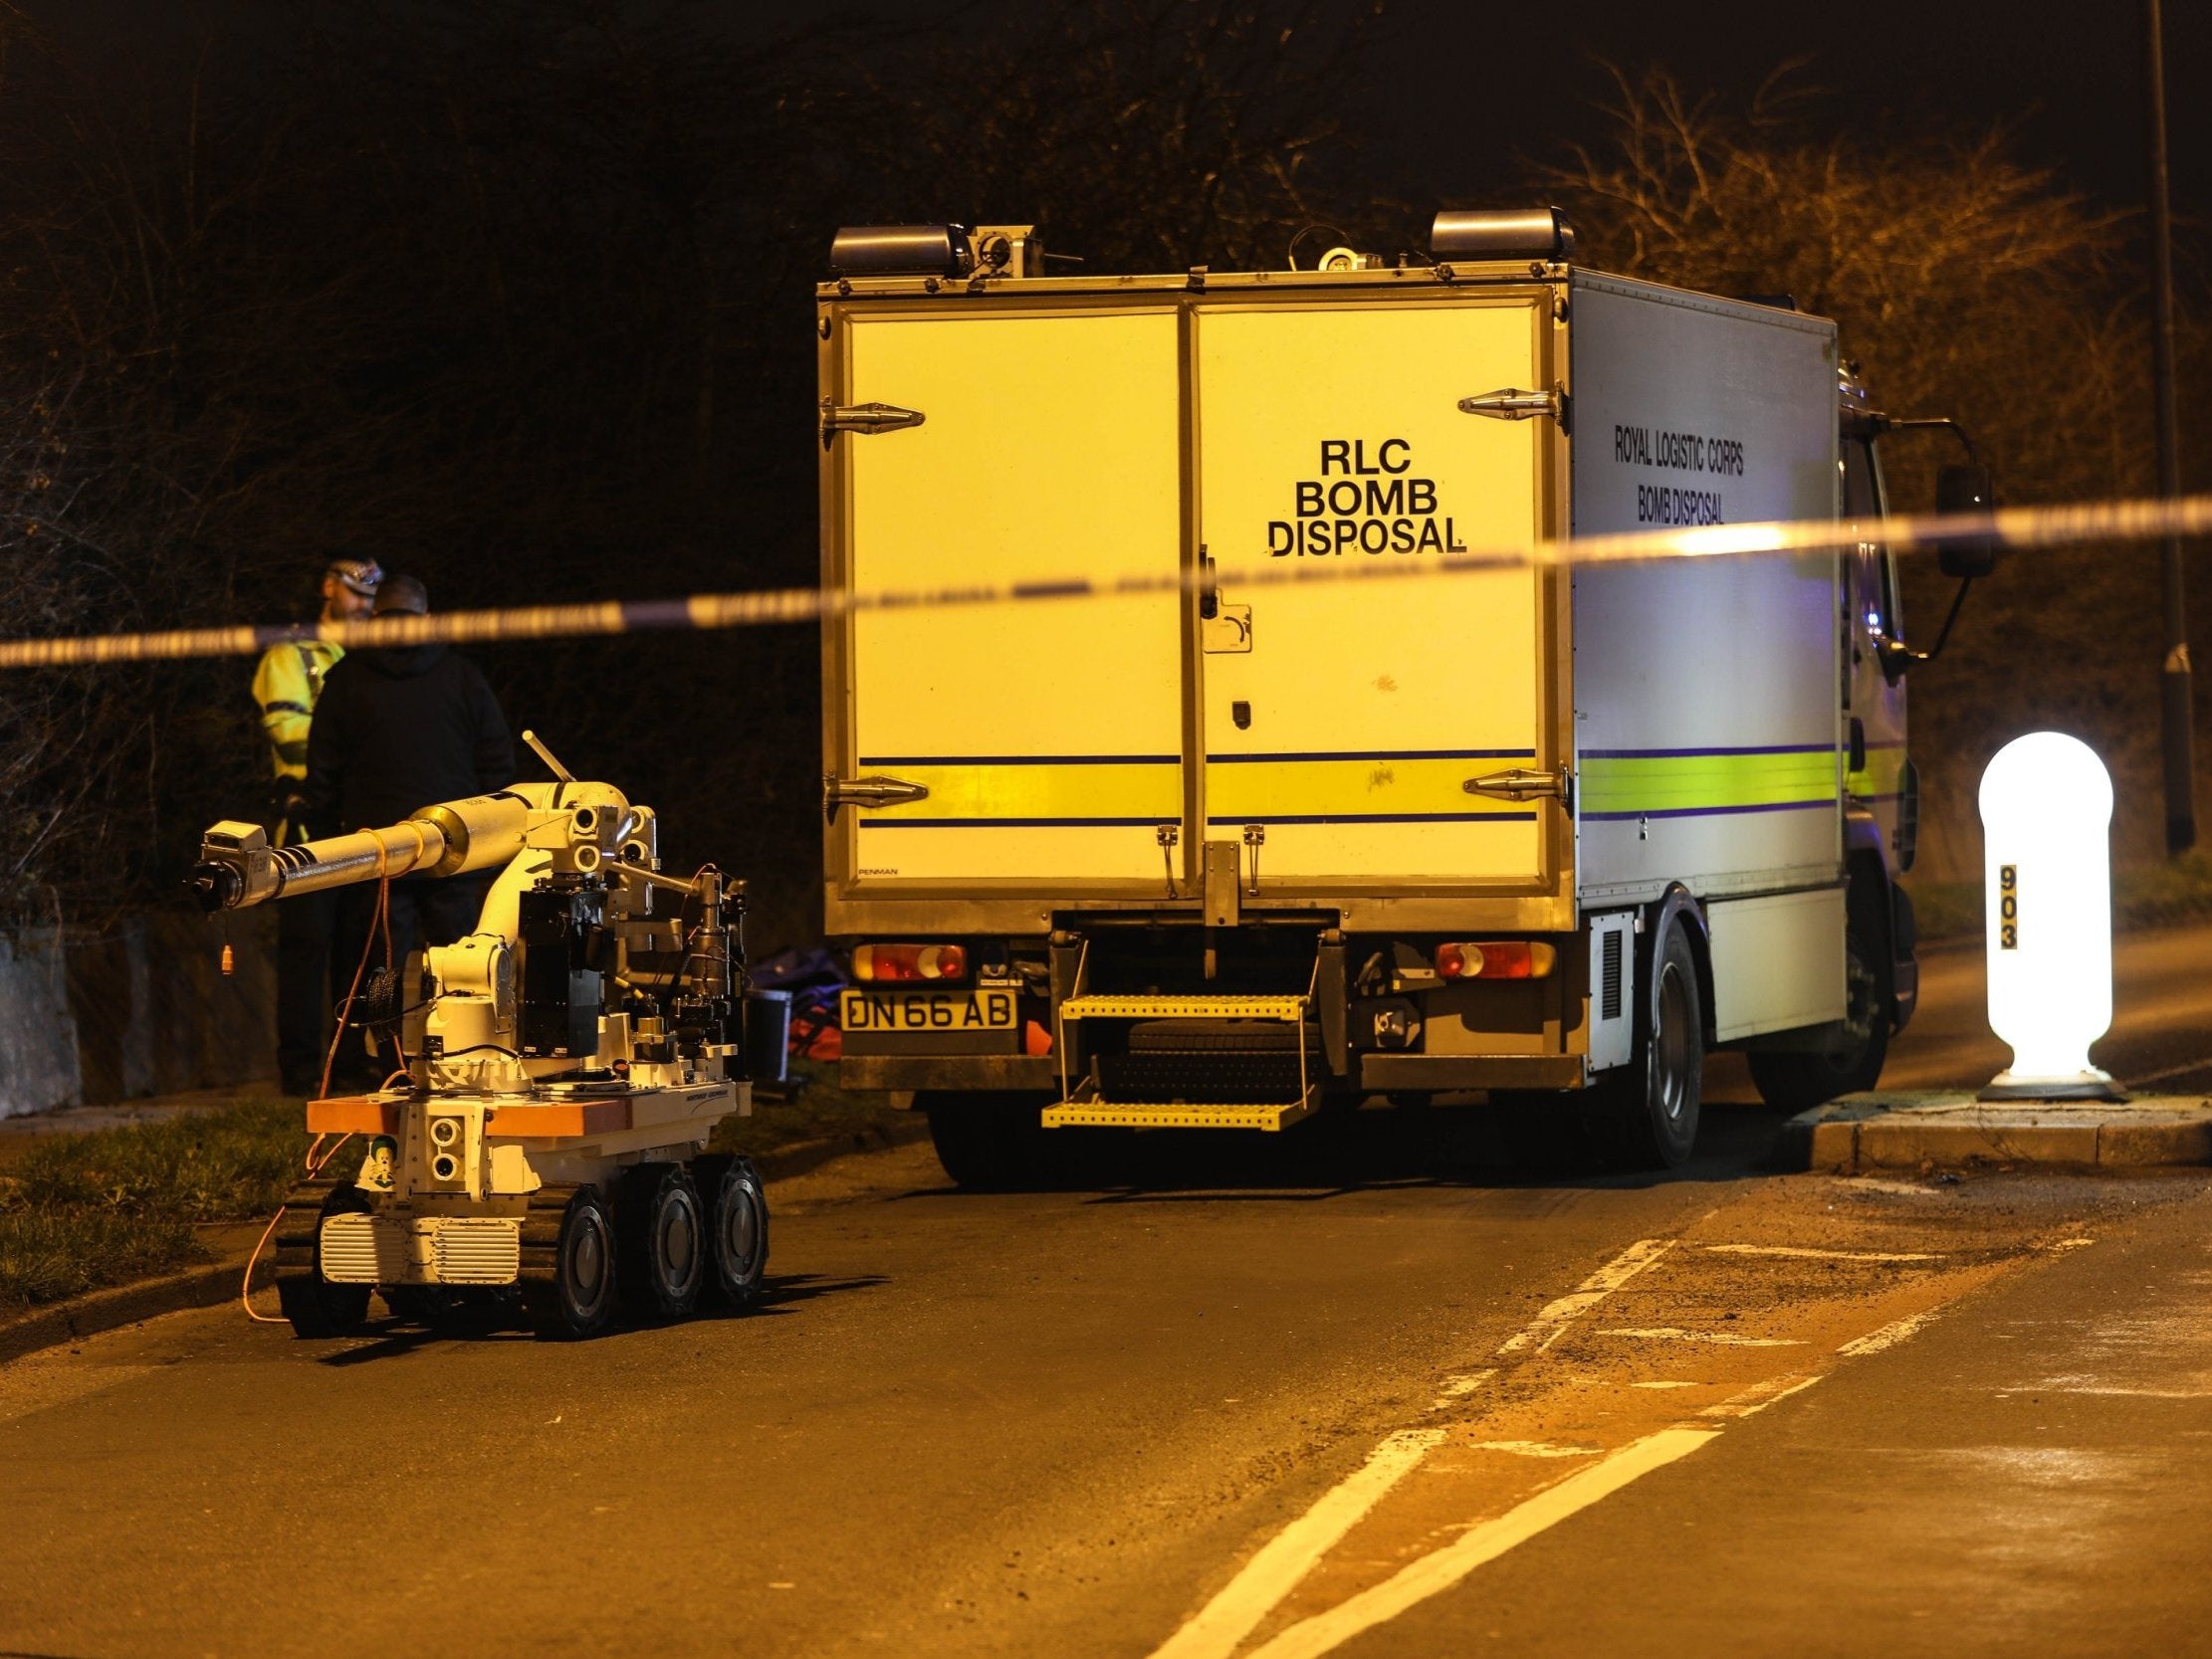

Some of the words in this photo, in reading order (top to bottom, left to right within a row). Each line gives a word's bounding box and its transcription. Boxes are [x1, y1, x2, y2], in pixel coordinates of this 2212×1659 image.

[1321, 439, 1411, 475] RLC
[1615, 425, 1652, 466] ROYAL
[1656, 430, 1703, 472] LOGISTIC
[1707, 438, 1743, 477] CORPS
[1296, 479, 1438, 518] BOMB
[1638, 485, 1671, 523] BOMB
[1672, 489, 1724, 525] DISPOSAL
[1268, 518, 1467, 557] DISPOSAL
[2000, 867, 2017, 947] 903
[847, 995, 896, 1028] DN
[904, 996, 953, 1027] 66
[963, 994, 1011, 1026] AB
